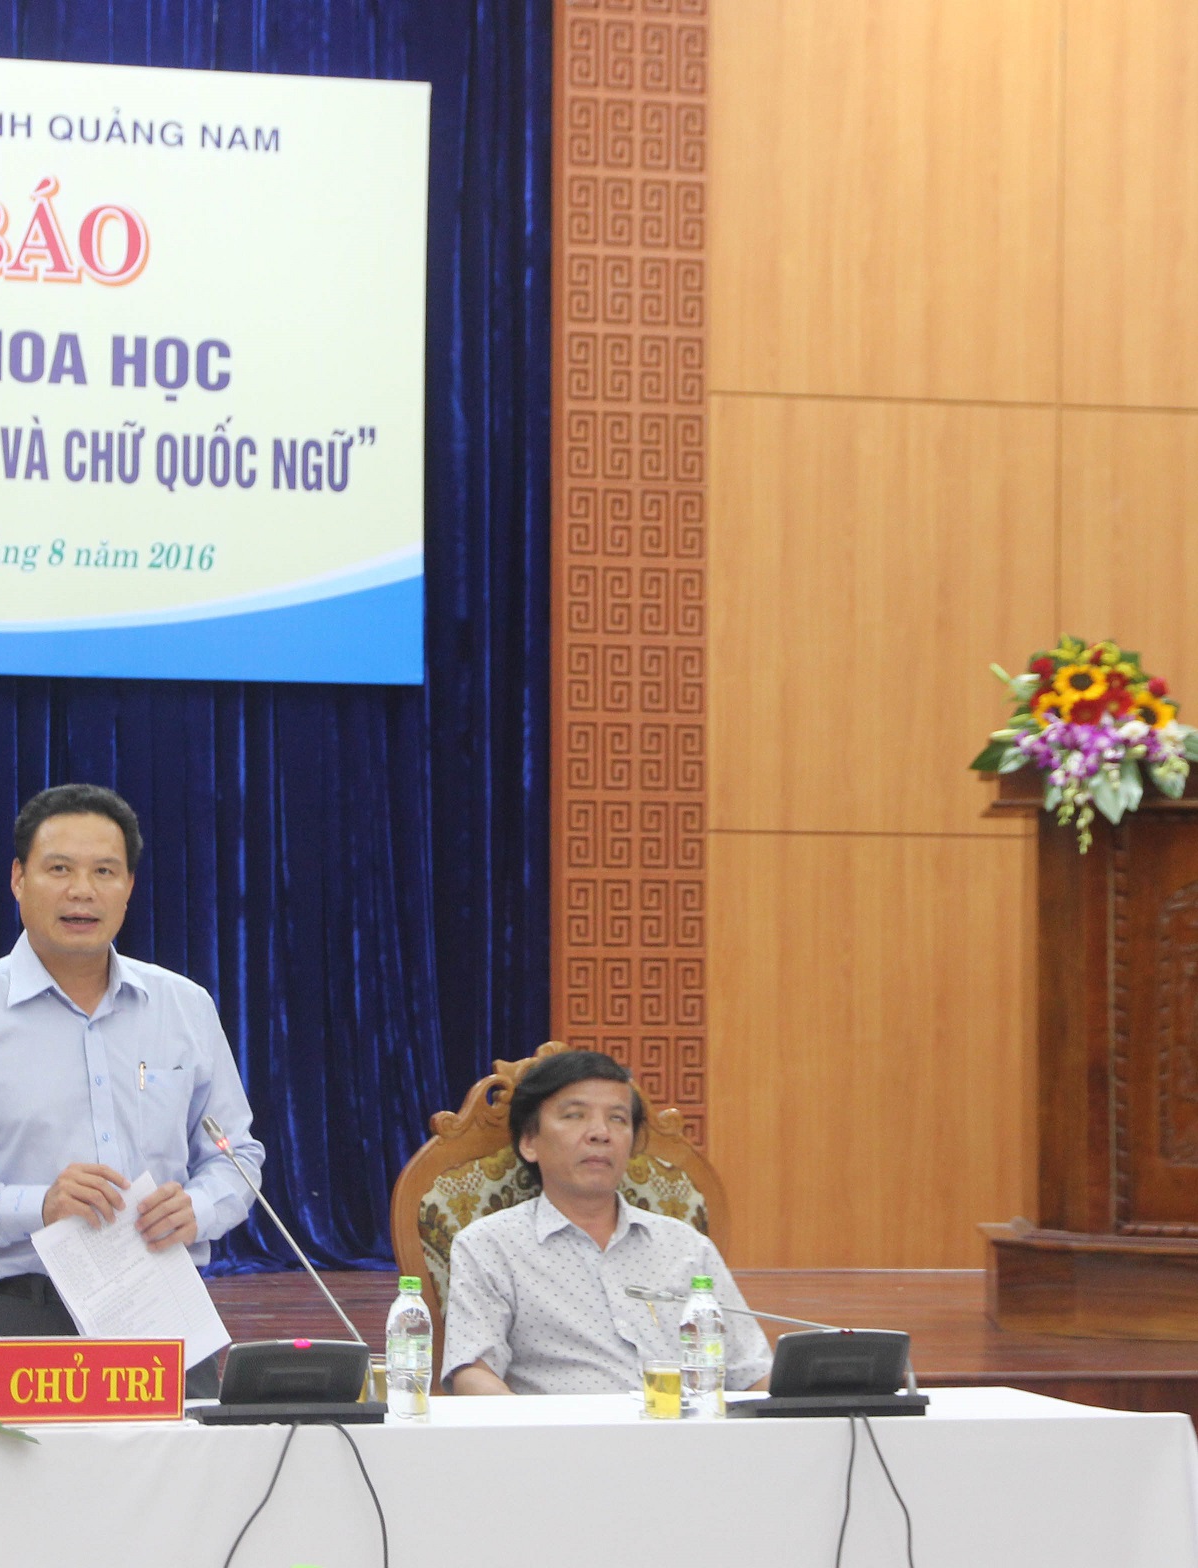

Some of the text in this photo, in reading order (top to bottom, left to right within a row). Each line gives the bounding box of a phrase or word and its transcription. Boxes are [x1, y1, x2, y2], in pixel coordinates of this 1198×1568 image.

[48, 107, 184, 147] QUẢNG
[200, 124, 280, 153] NAM
[111, 335, 231, 403] HỌC
[0, 416, 50, 481] VÀ
[63, 421, 146, 485] CHỮ
[155, 416, 257, 493] QUỐC
[47, 539, 66, 566] 8
[74, 540, 139, 569] năm
[147, 543, 215, 571] 2016
[9, 1352, 166, 1404] CHỦ TRÌ
